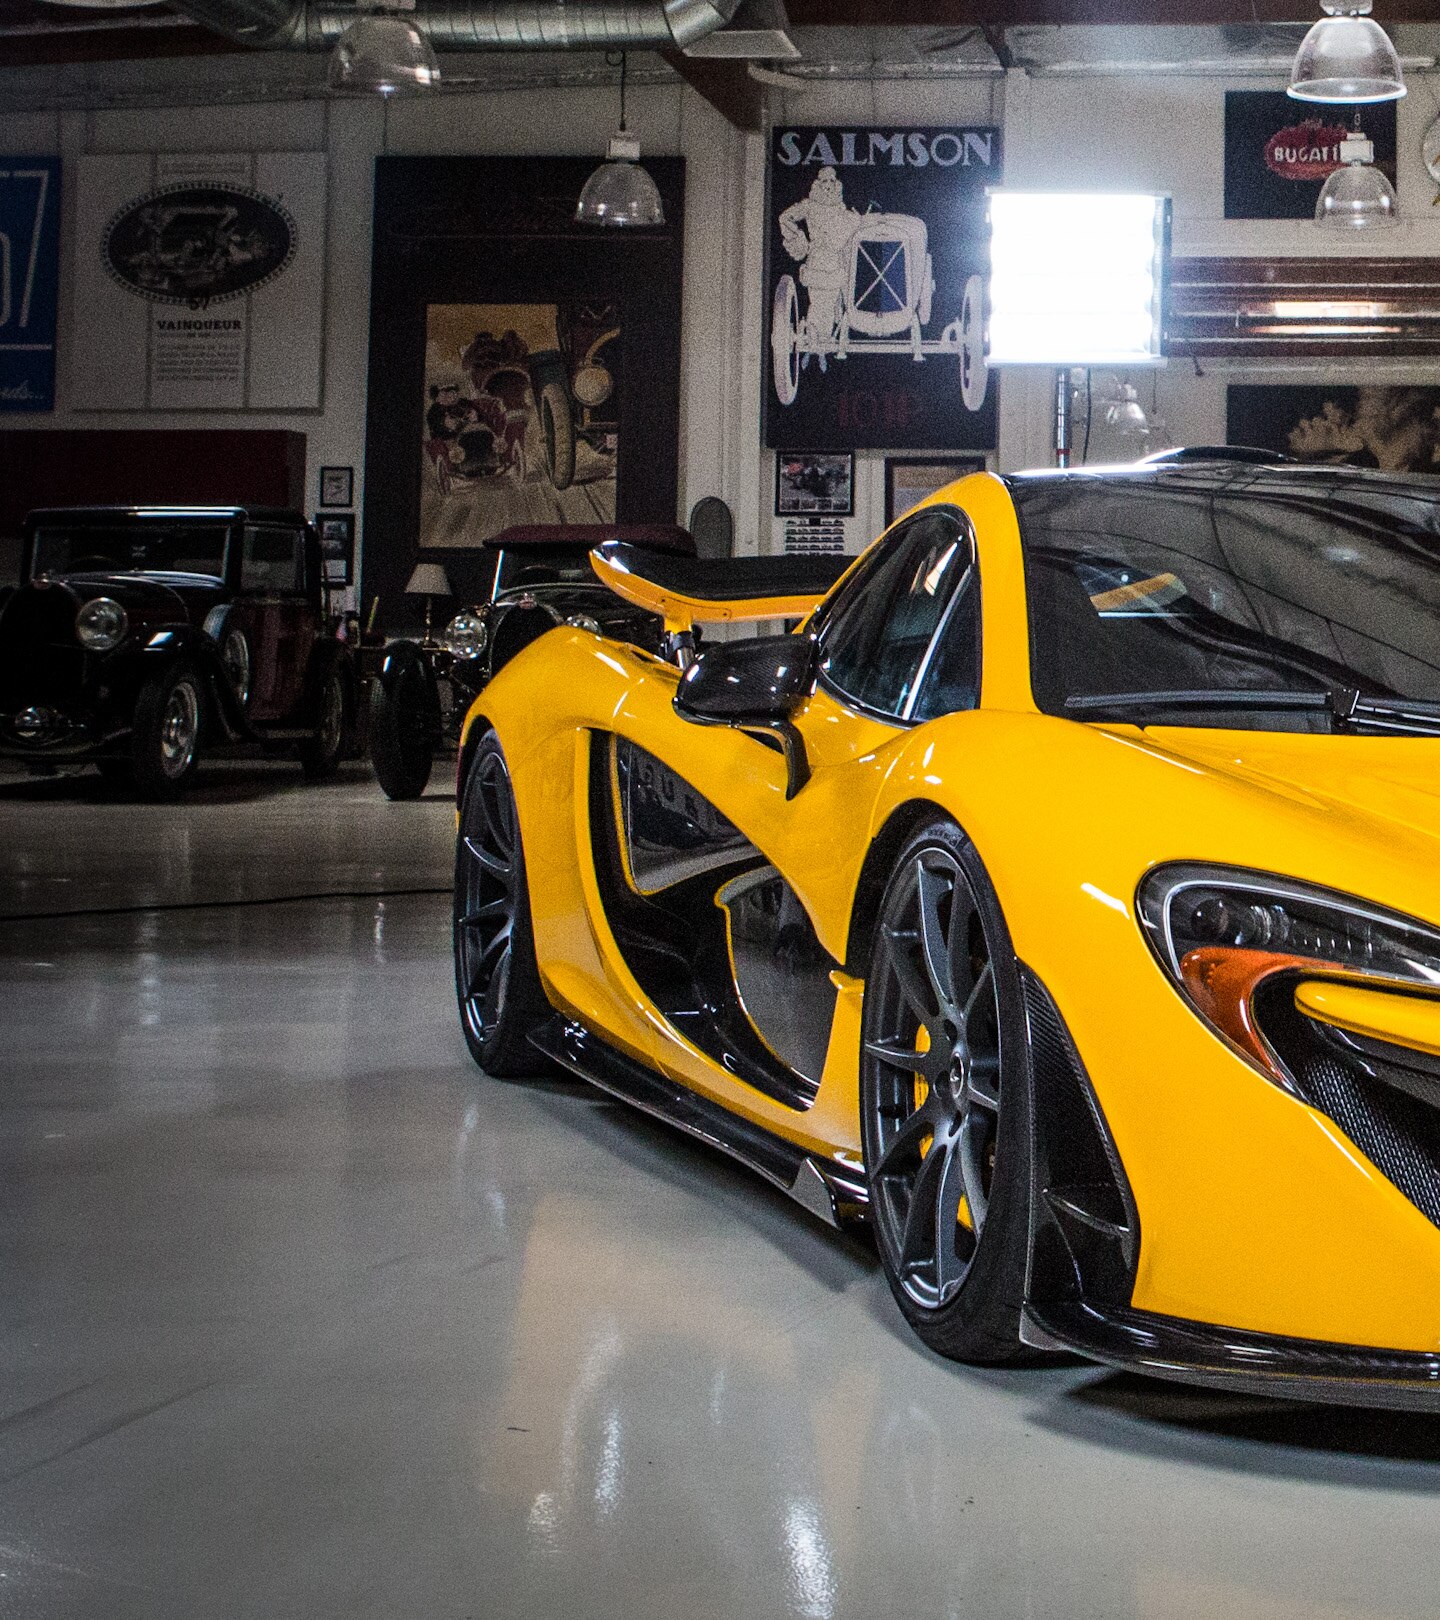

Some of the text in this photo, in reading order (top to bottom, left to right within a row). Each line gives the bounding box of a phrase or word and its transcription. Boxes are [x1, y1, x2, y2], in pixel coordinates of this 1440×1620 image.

[777, 131, 993, 168] SALMSON
[1274, 143, 1339, 163] BUGATT
[156, 320, 241, 331] VAINQUEUR
